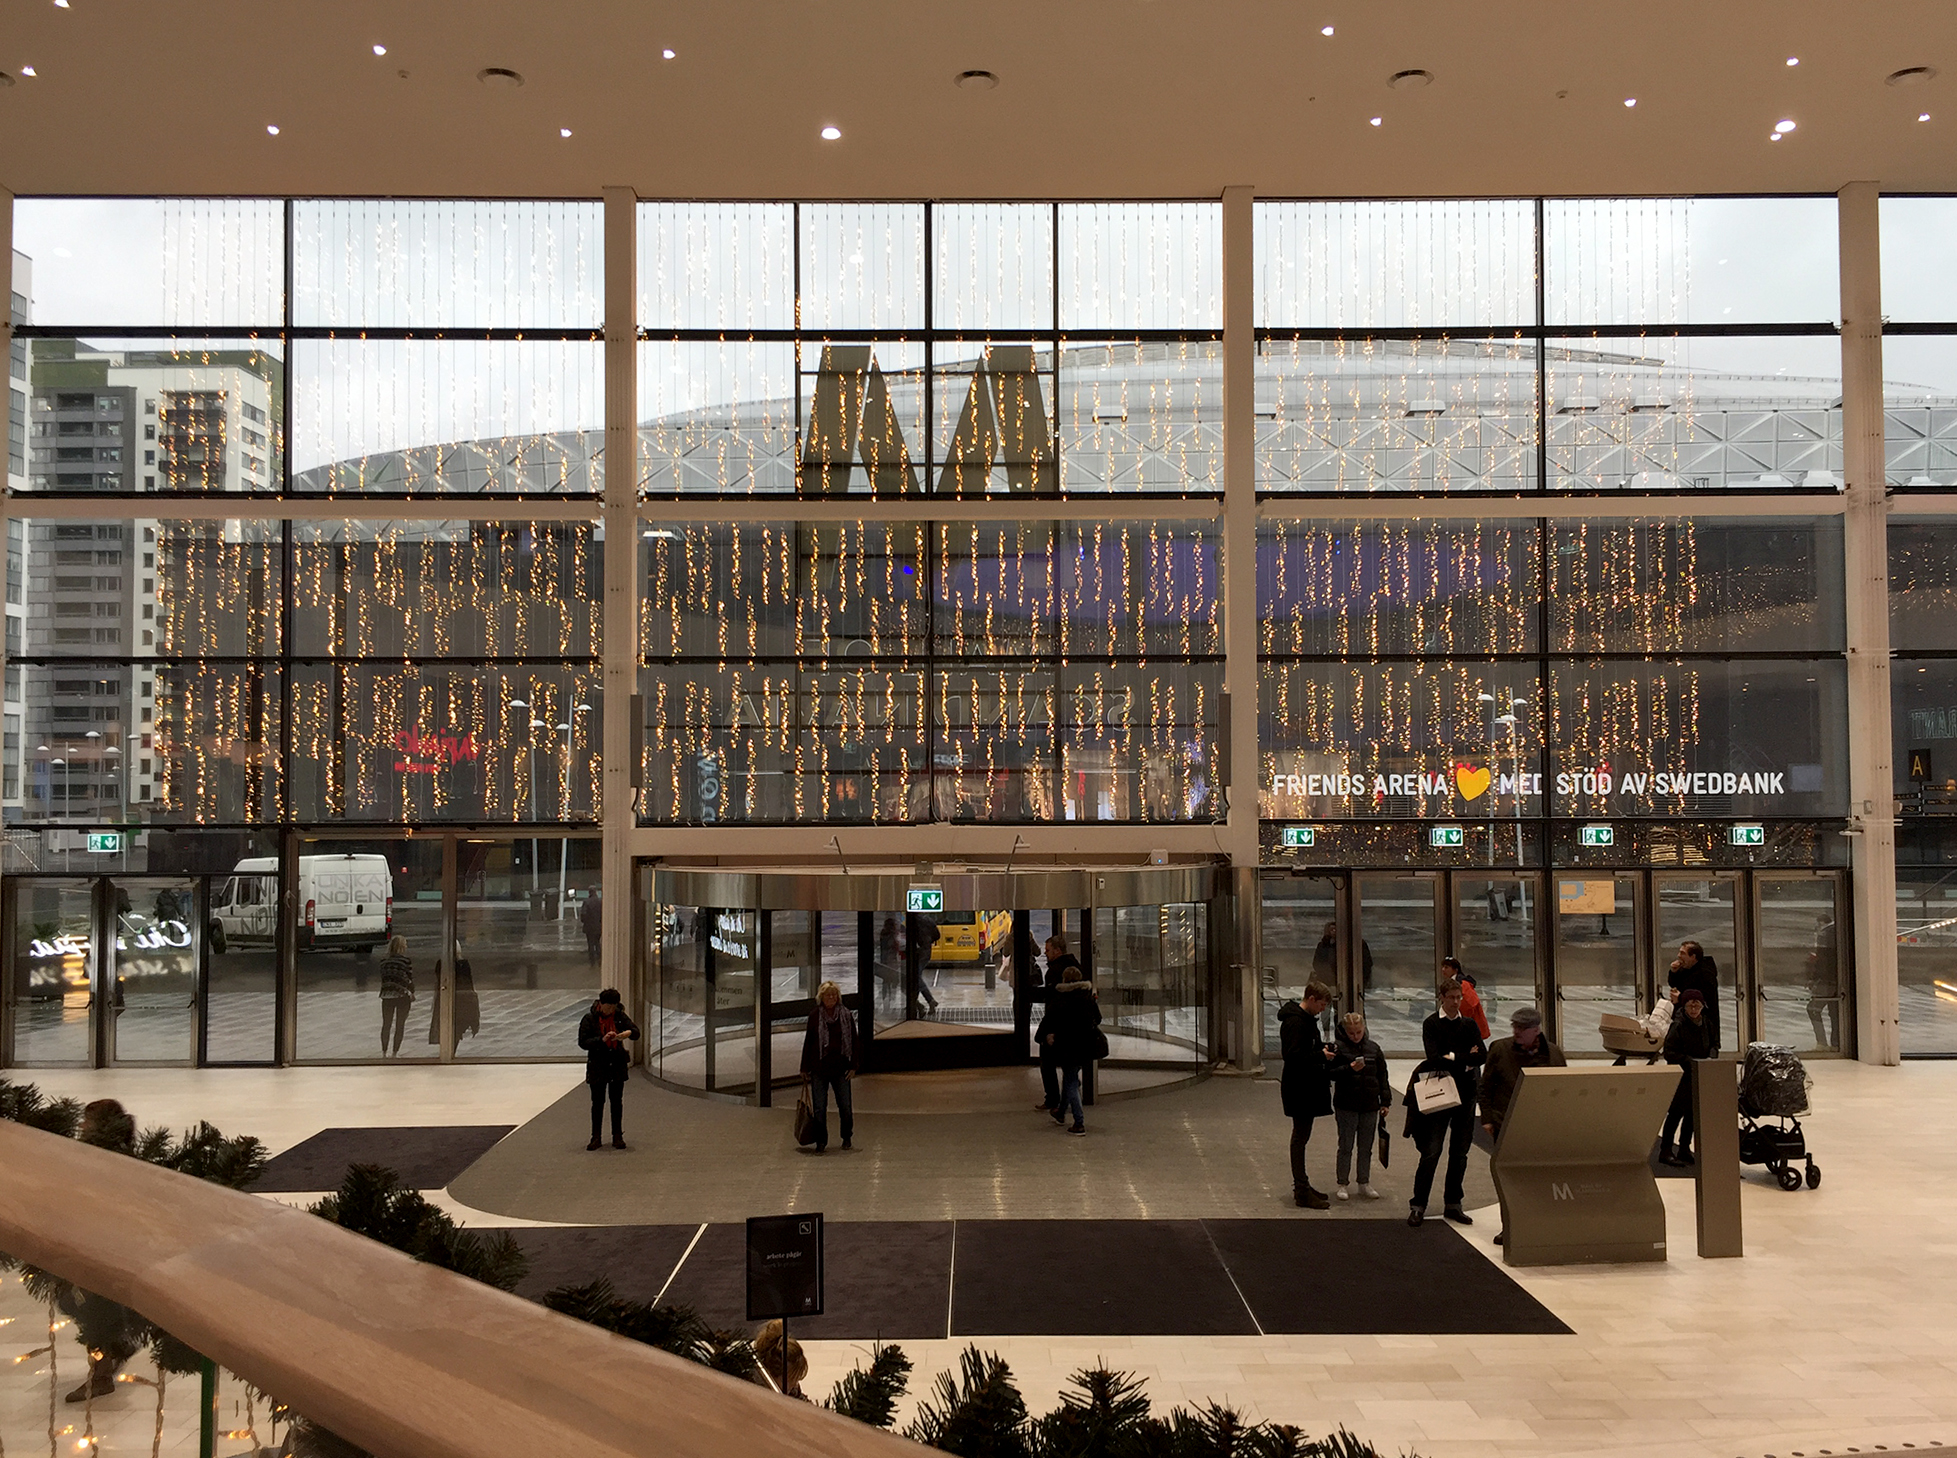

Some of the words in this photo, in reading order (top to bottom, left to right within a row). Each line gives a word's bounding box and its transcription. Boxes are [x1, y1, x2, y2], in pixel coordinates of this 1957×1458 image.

[1911, 755, 1924, 776] A
[1273, 773, 1365, 796] FRIENDS
[1373, 773, 1449, 796] ARENA
[1556, 767, 1612, 795] STÖD
[1620, 772, 1648, 795] AV
[1655, 772, 1785, 795] SWEDBANK
[1552, 1182, 1575, 1200] M
